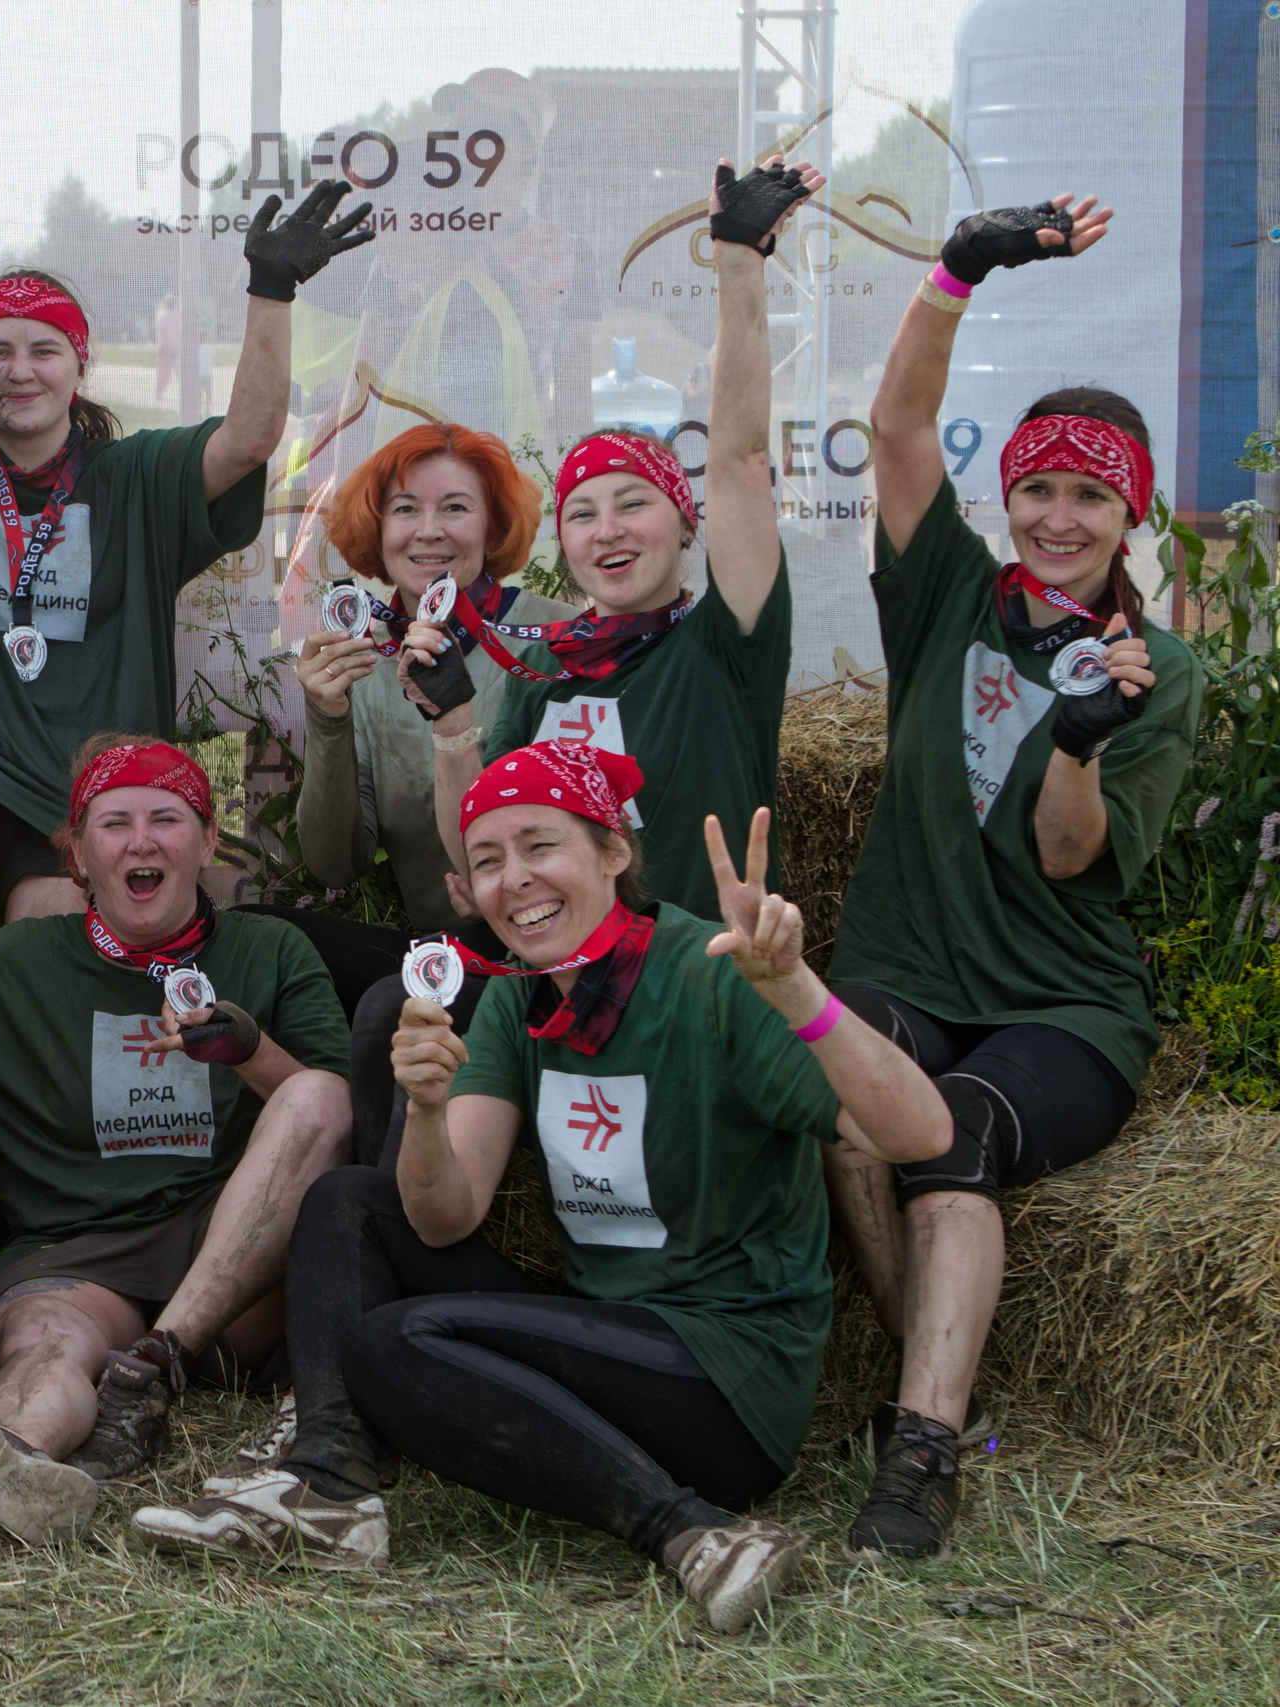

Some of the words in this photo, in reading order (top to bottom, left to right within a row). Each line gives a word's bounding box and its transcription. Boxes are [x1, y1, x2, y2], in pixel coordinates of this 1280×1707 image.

[136, 130, 399, 200] РОДЕО
[422, 129, 505, 189] 59
[410, 206, 502, 232] забег
[3, 509, 18, 527] 59
[15, 542, 42, 597] РОДЕО
[35, 522, 52, 540] 59
[1040, 586, 1080, 609] РОДЕО
[518, 627, 542, 638] 59
[89, 918, 125, 958] РОДЕО
[129, 1085, 176, 1107] ржд
[95, 1111, 213, 1134] медицина
[104, 1133, 209, 1152] КРИСТИНА
[572, 1173, 614, 1195] ржд
